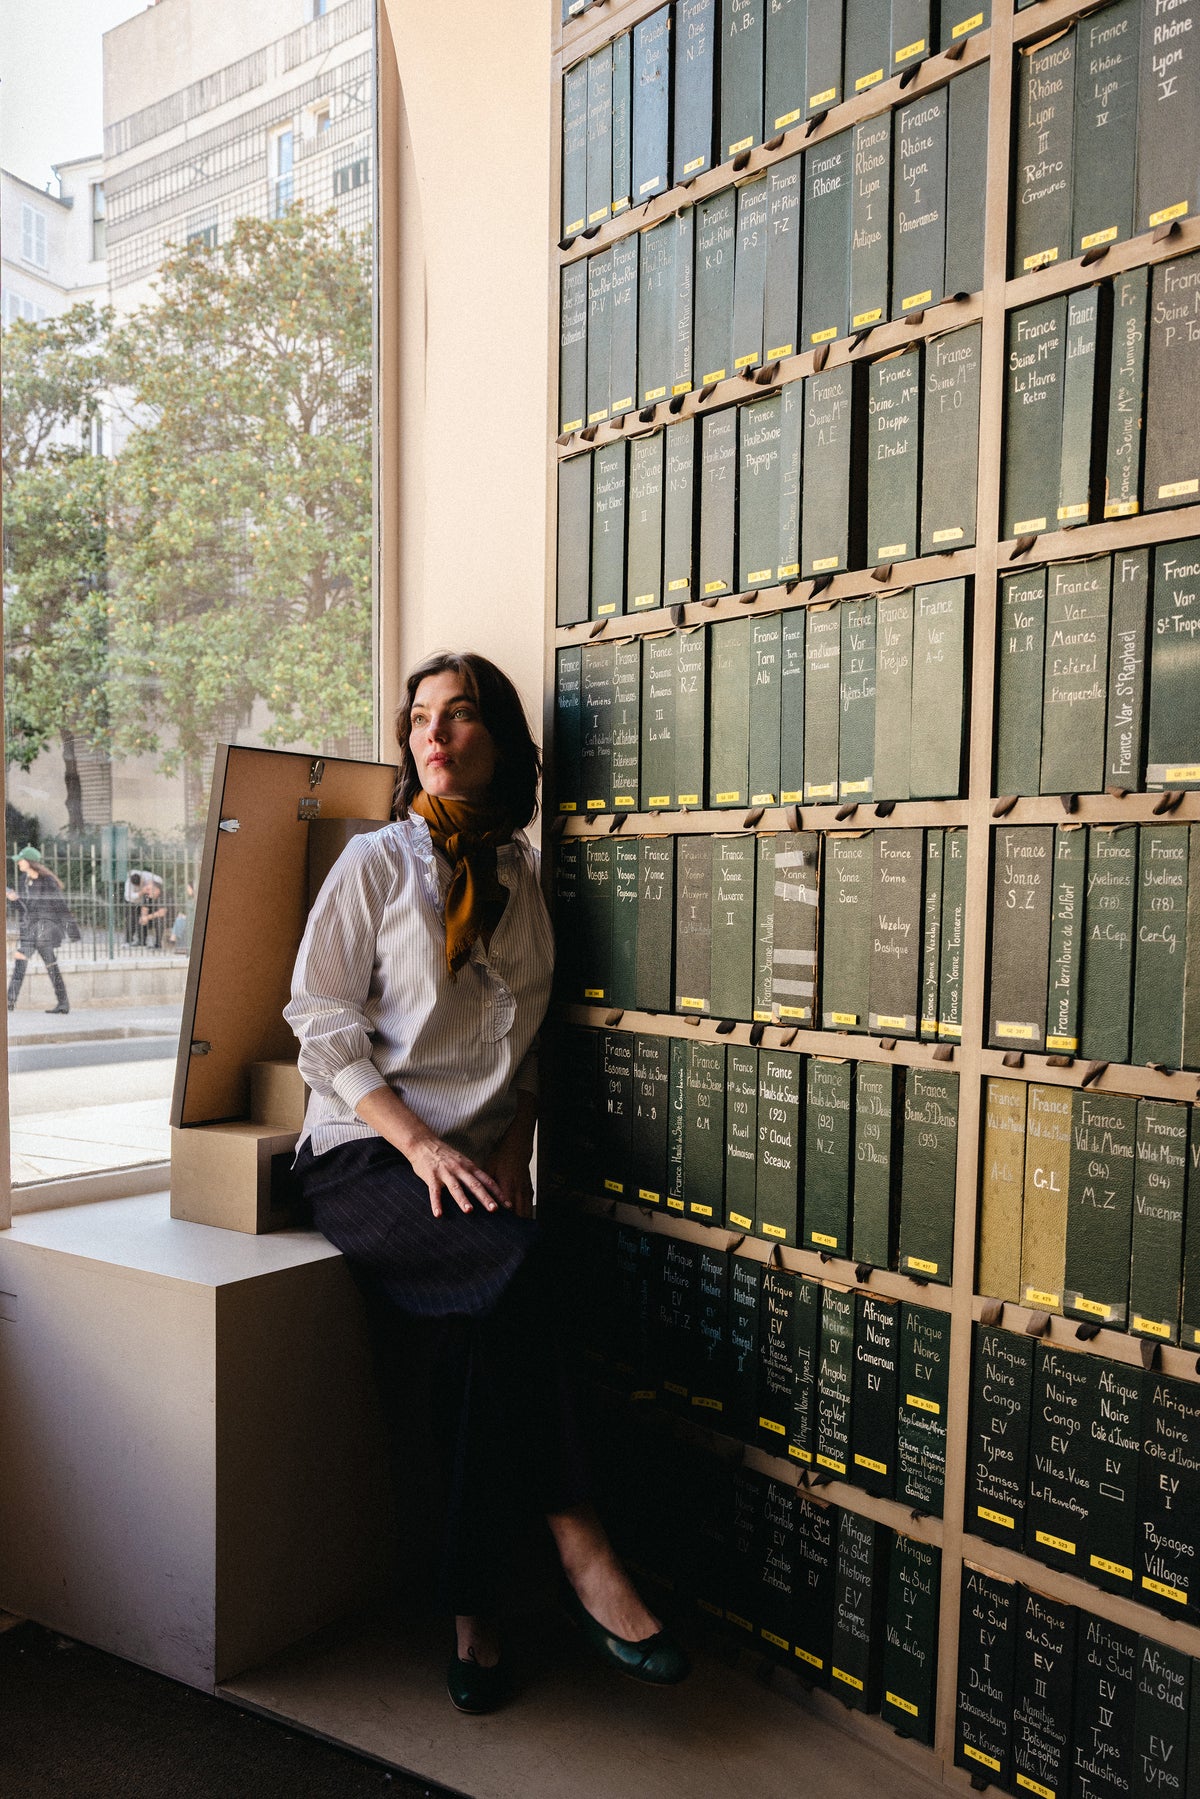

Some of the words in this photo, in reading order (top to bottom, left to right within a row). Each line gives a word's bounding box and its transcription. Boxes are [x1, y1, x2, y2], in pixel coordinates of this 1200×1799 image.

[688, 23, 705, 40] Oise
[1090, 20, 1128, 48] France
[1154, 19, 1192, 45] Rhône
[1029, 47, 1071, 74] France
[1152, 49, 1183, 77] Lyon
[1029, 79, 1063, 103] Rhône
[1095, 82, 1118, 107] Lyon
[1158, 76, 1177, 101] V
[901, 105, 940, 133] France
[1028, 106, 1055, 133] Lyon
[857, 127, 888, 151] France
[901, 135, 933, 159] Rhône
[812, 154, 841, 175] France
[855, 154, 885, 175] Rhône
[903, 162, 928, 187] Lyon
[1024, 161, 1063, 184] Rétro
[813, 177, 841, 198] Rhône
[900, 210, 938, 233] Panoramas
[853, 229, 881, 249] Antique
[613, 249, 636, 268] France
[1154, 302, 1189, 323] Seine
[1017, 318, 1056, 341] France
[1010, 352, 1035, 371] Seine
[879, 368, 912, 387] France
[1015, 376, 1025, 392] Le
[1029, 371, 1056, 388] Havre
[878, 415, 909, 432] Dieppe
[1122, 560, 1139, 582] Fr
[1056, 574, 1099, 596] France
[920, 598, 953, 617] France
[1174, 590, 1195, 607] Var
[1014, 612, 1034, 628] Var
[1065, 605, 1086, 620] Var
[928, 629, 944, 644] Var
[1051, 630, 1096, 646] Maures
[650, 644, 672, 659] France
[757, 651, 774, 666] Tarn
[756, 671, 770, 685] Albi
[650, 685, 672, 699] Amiens
[1115, 704, 1133, 727] Var
[658, 728, 670, 740] ville
[721, 845, 743, 860] France
[880, 841, 911, 859] France
[1005, 835, 1045, 858] France
[1097, 842, 1130, 858] France
[1151, 840, 1183, 859] France
[587, 864, 608, 885] Vosges
[644, 867, 664, 882] Yonne
[722, 868, 742, 881] Yonne
[881, 869, 906, 883] Yonne
[1004, 865, 1040, 885] Yonne
[1144, 869, 1182, 886] Yvelines
[718, 887, 743, 901] Auxerre
[839, 890, 858, 903] Sens
[1059, 883, 1075, 919] Belfort
[1100, 897, 1120, 908] (78)
[1151, 897, 1174, 910] (78)
[878, 915, 911, 937] Vezelay
[1062, 925, 1072, 935] de
[875, 939, 909, 959] Basilique
[1053, 999, 1068, 1036] France
[733, 1058, 753, 1073] France
[767, 1062, 792, 1079] France
[769, 1108, 786, 1123] (92)
[1082, 1101, 1125, 1130] France
[732, 1124, 749, 1138] Rueil
[770, 1129, 791, 1147] Cloud
[1146, 1117, 1187, 1138] France
[919, 1134, 937, 1148] (93)
[764, 1151, 791, 1169] Sceaux
[1089, 1161, 1109, 1179] (94)
[1149, 1173, 1170, 1189] (94)
[763, 1275, 793, 1298] Afrique
[864, 1301, 894, 1329] Afrique
[867, 1326, 890, 1347] Noire
[857, 1346, 894, 1371] Cameroun
[982, 1336, 1027, 1367] Afrique
[821, 1359, 847, 1383] Angola
[987, 1364, 1015, 1386] Noire
[1042, 1355, 1087, 1386] Afrique
[868, 1375, 880, 1391] EV
[1099, 1371, 1138, 1405] Afrique
[983, 1386, 1020, 1415] Congo
[819, 1400, 833, 1424] Cap
[832, 1406, 845, 1423] Vert
[1044, 1407, 1080, 1436] Congo
[1101, 1399, 1129, 1424] Noire
[980, 1435, 1014, 1463] Types
[1051, 1436, 1069, 1454] EV
[1106, 1459, 1121, 1474] EV
[976, 1464, 1019, 1491] Danses
[800, 1500, 829, 1527] Afrique
[1144, 1523, 1194, 1559] Paysages
[896, 1535, 932, 1569] Afrique
[900, 1567, 911, 1584] du
[911, 1571, 930, 1595] Sud
[1145, 1553, 1189, 1589] Villages
[967, 1575, 1009, 1607] Afrique
[973, 1605, 984, 1620] du
[988, 1612, 1007, 1631] Sud
[1025, 1597, 1065, 1630] Afrique
[1026, 1629, 1040, 1645] du
[1041, 1635, 1063, 1654] Sud
[1087, 1622, 1135, 1660] Afrique
[1088, 1650, 1101, 1666] du
[1106, 1656, 1132, 1680] Sud
[1142, 1648, 1184, 1688] Afrique
[969, 1668, 1003, 1701] Durban
[1100, 1680, 1116, 1700] EV
[1139, 1677, 1153, 1695] du
[1157, 1684, 1184, 1710] Sud
[1099, 1706, 1113, 1727] IV
[1091, 1727, 1120, 1759] Types
[1075, 1747, 1129, 1790] Industries
[1141, 1754, 1179, 1788] Types
